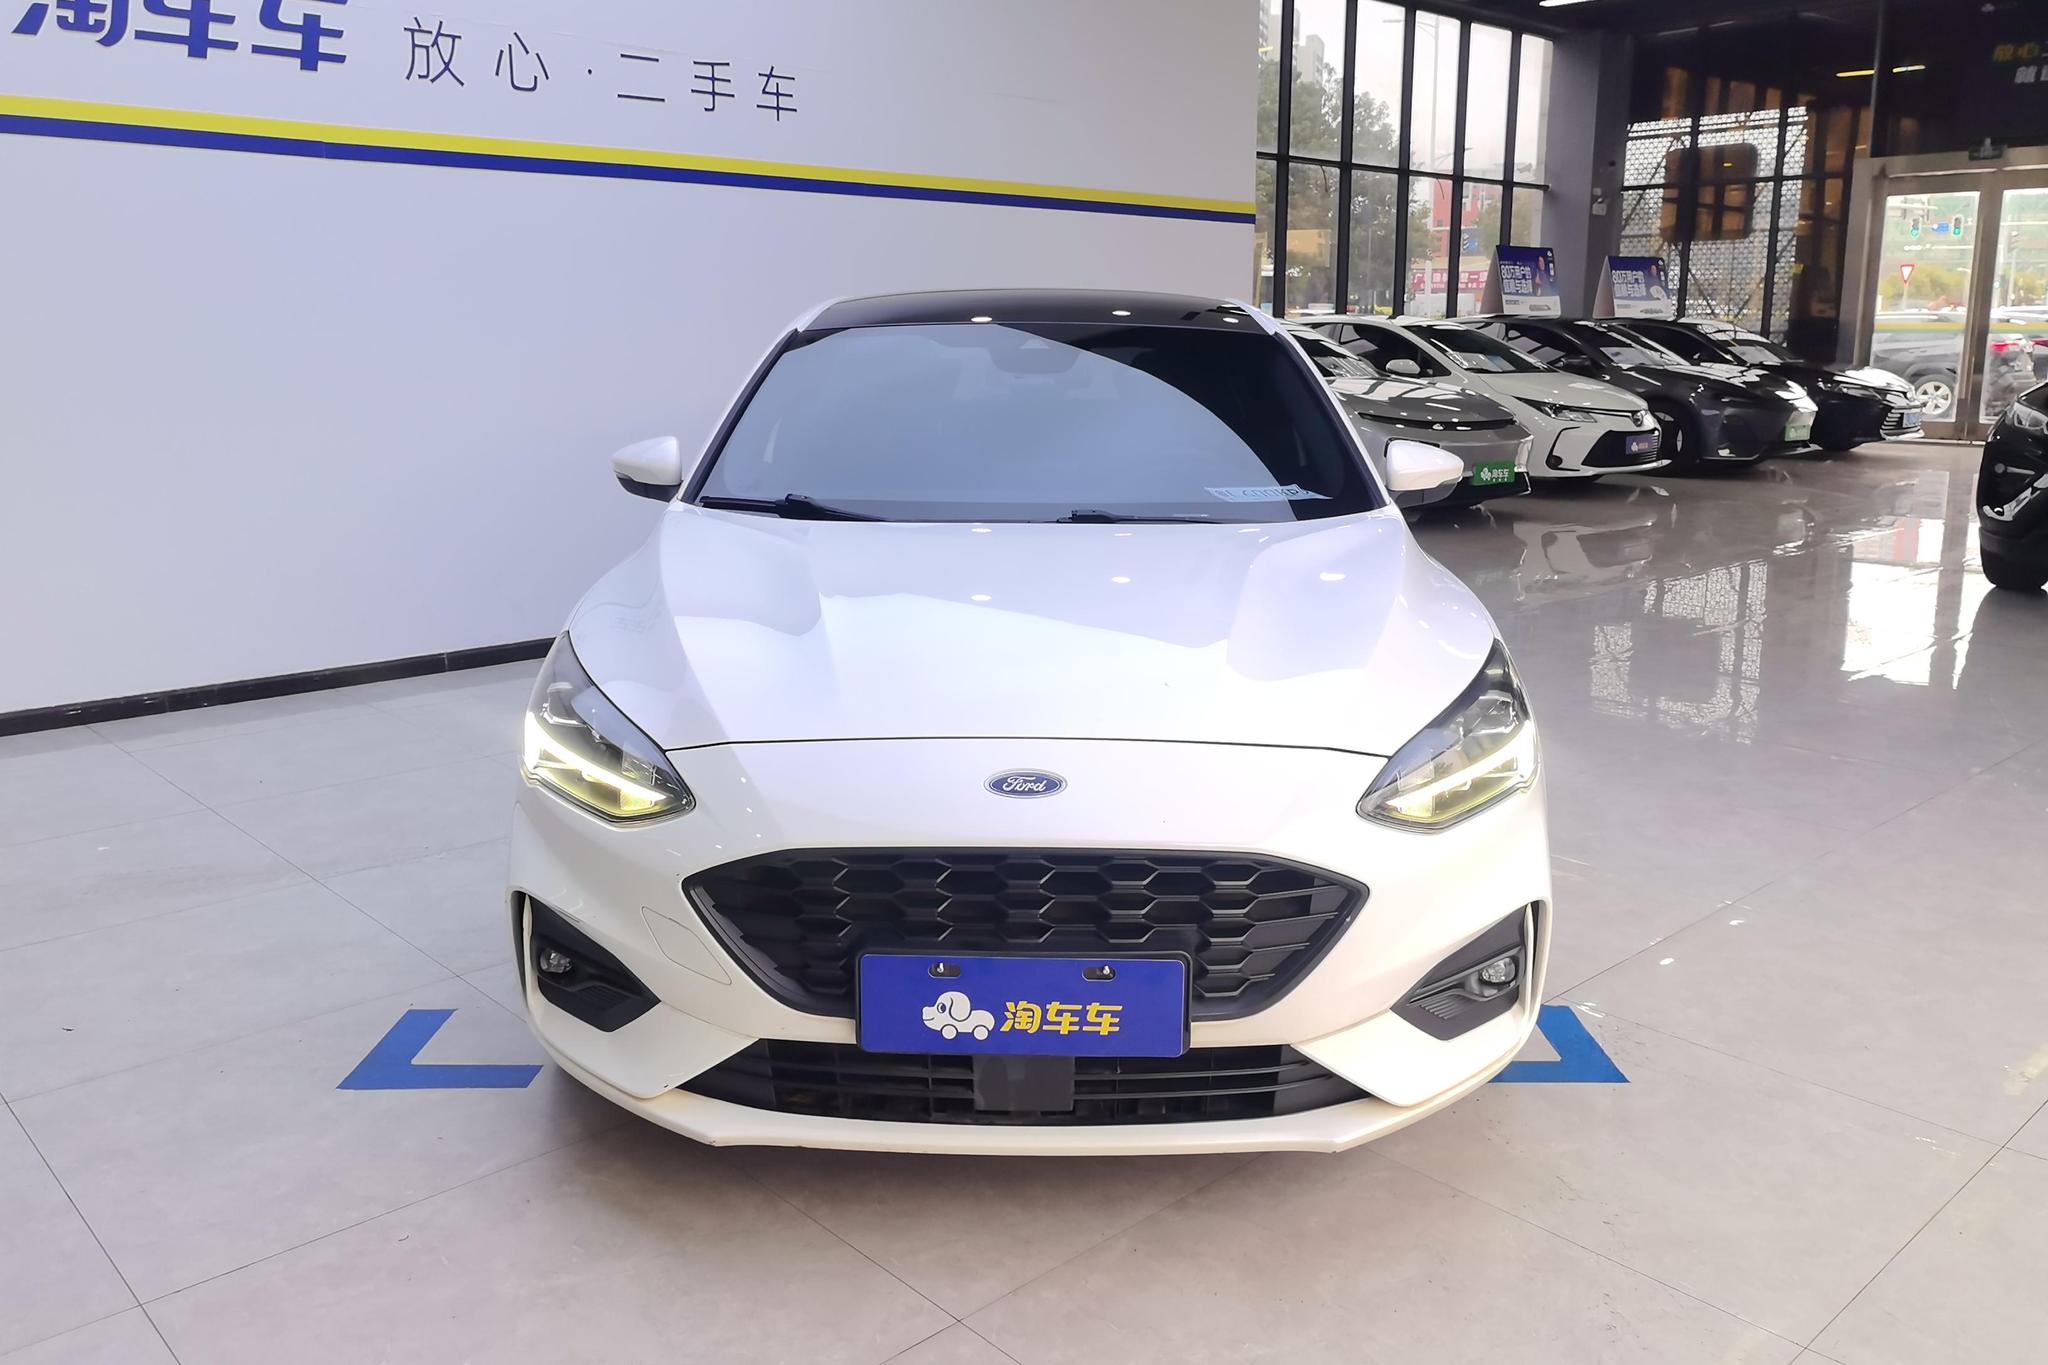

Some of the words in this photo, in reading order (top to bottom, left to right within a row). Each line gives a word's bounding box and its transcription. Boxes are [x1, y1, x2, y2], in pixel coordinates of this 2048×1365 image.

[1002, 775, 1047, 792] Ford
[999, 1000, 1123, 1036] 淘车车
